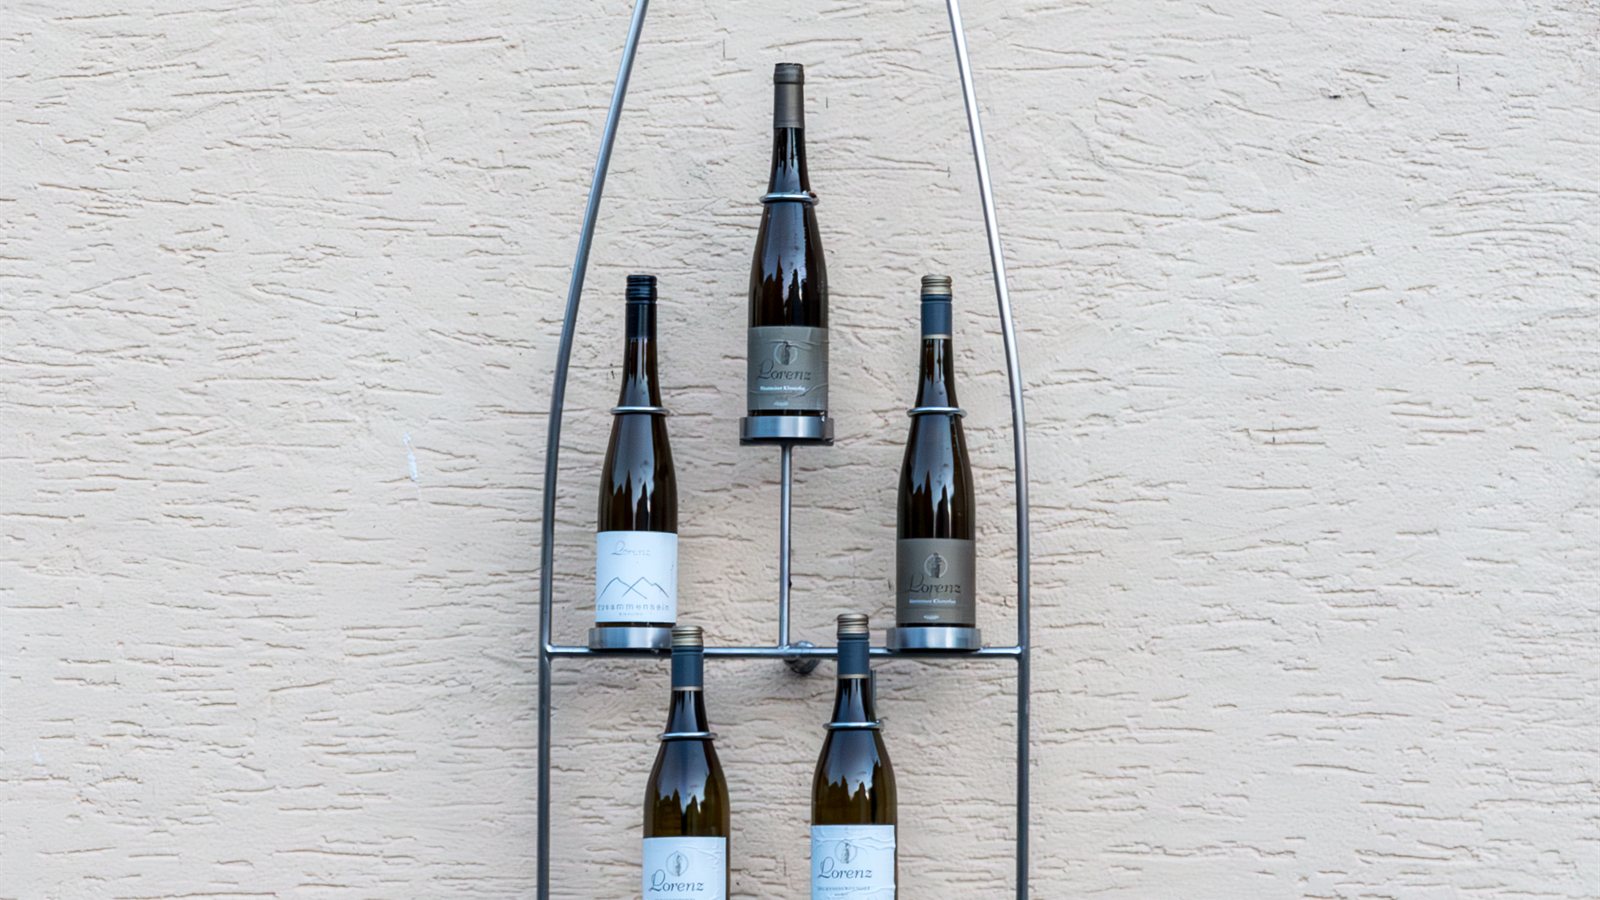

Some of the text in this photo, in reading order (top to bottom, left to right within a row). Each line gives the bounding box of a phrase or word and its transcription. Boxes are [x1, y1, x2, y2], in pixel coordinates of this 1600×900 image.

[756, 359, 811, 380] Lorenz
[906, 573, 961, 593] Lorenz
[817, 856, 872, 879] Lorenz
[648, 869, 704, 892] Lorenz
